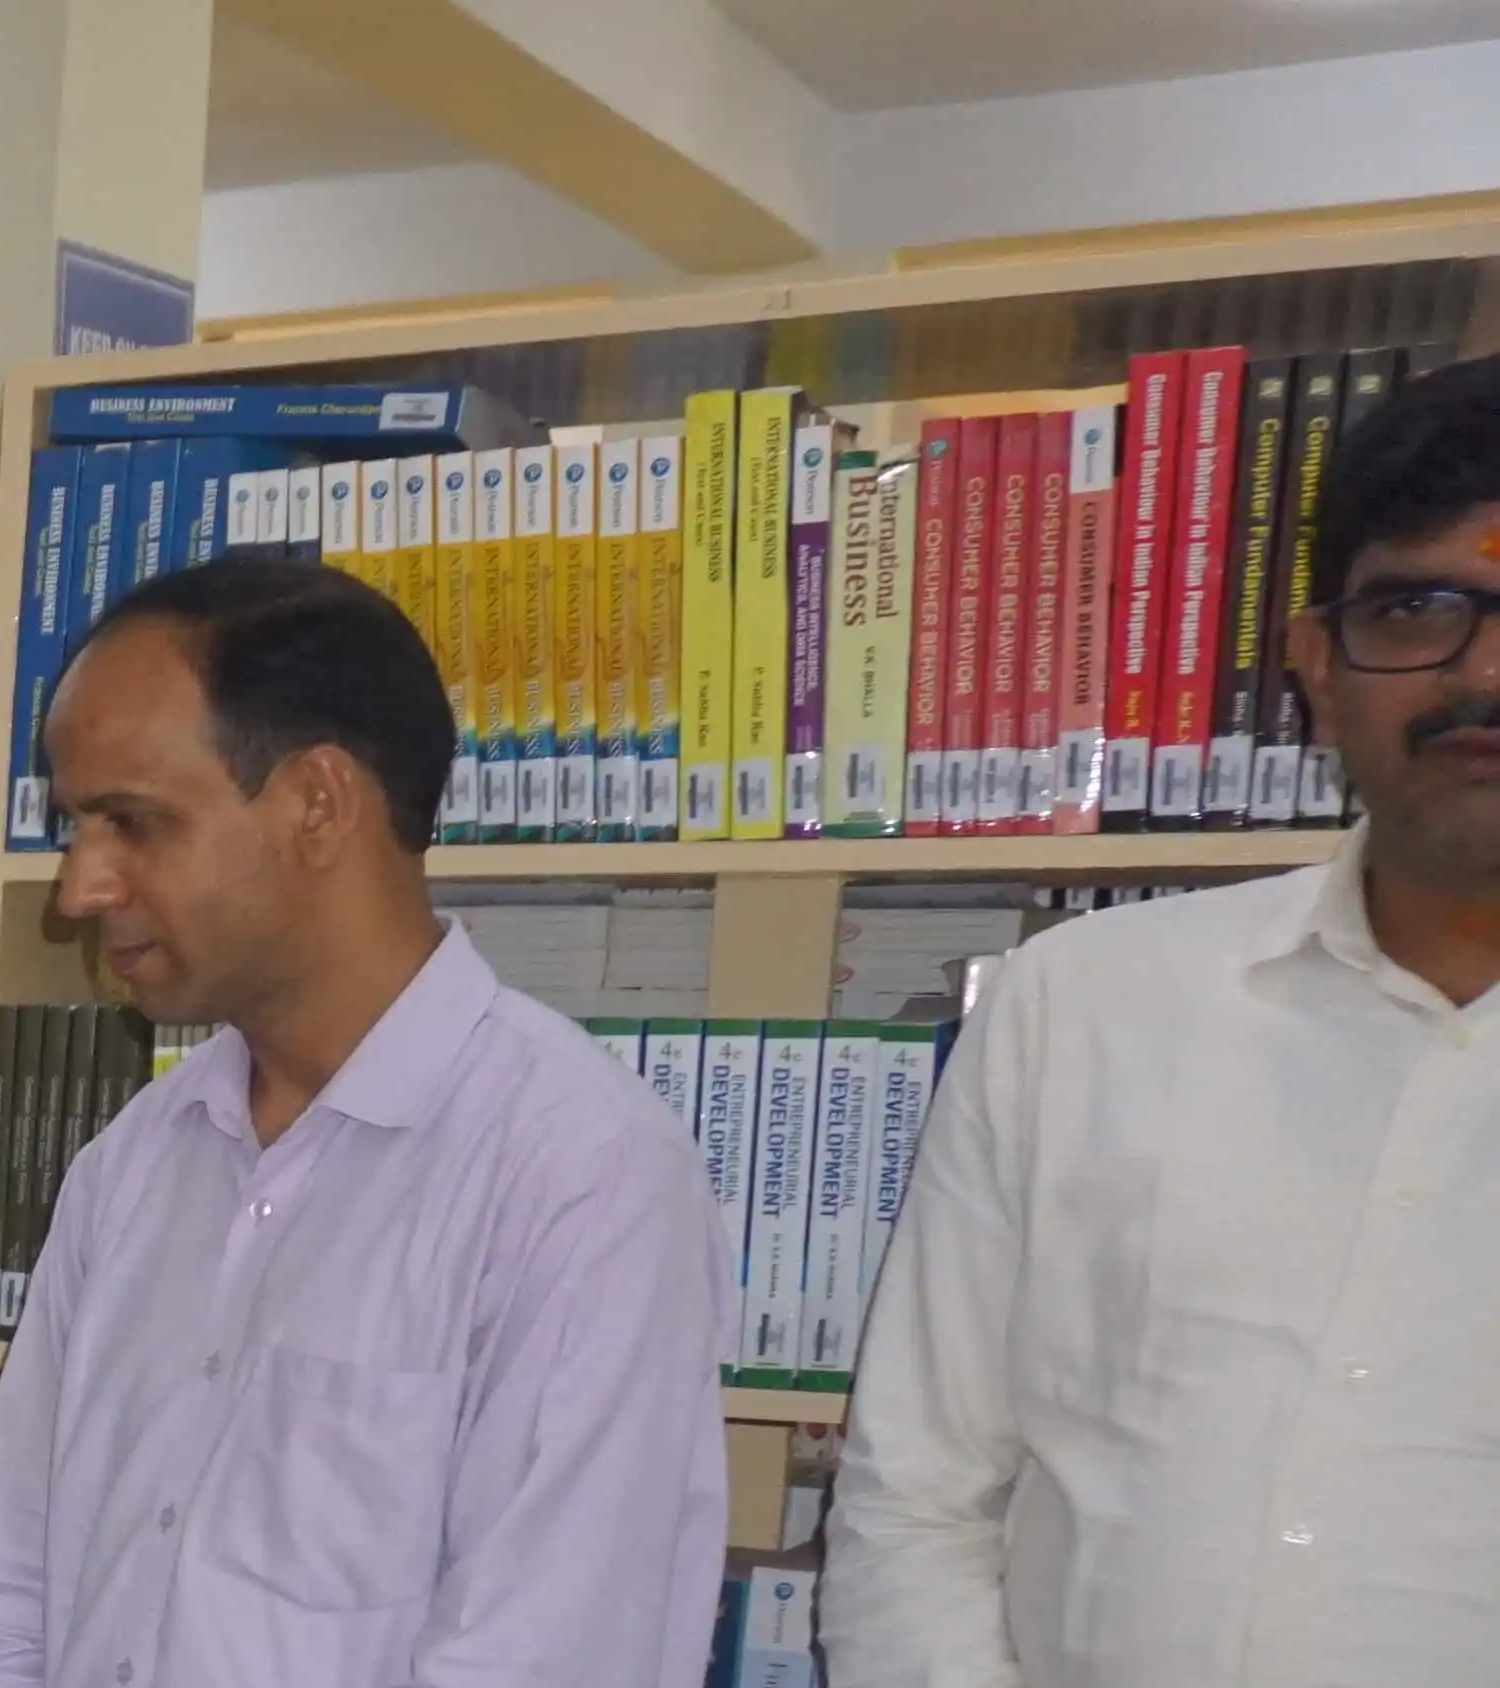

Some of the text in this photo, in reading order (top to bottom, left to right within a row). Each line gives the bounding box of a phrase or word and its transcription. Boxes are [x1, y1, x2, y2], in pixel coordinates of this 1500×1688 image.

[90, 398, 236, 414] BUSINESS ENVIRONMENT
[1144, 374, 1167, 446] Consumer
[1199, 371, 1224, 446] Consumer
[1299, 416, 1330, 517] Computer
[100, 484, 116, 544] BUSINESS
[876, 474, 902, 619] nternational
[1137, 446, 1162, 522] Behaviour
[1189, 446, 1218, 522] Behaviour
[1235, 418, 1282, 670] Computer Fundamentals
[41, 487, 66, 635] BUSINESS ENVIRONMENT
[844, 476, 878, 627] Business
[954, 476, 985, 696] CONSUMER BEHAVIOR
[996, 474, 1025, 694] CONSUMER BEHAVIOR
[1033, 472, 1063, 694] CONSUMER BEHAVIOR
[1074, 501, 1098, 706] CONSUMER BEHAVIOR
[1132, 541, 1156, 588] Indian
[1183, 541, 1209, 588] Indian
[917, 518, 943, 725] CONSUMER BEHAVIOR
[1124, 590, 1152, 675] Perspective
[1176, 590, 1204, 676] Perspective
[721, 1074, 747, 1206] ENTREPRENEURIAL
[763, 1068, 791, 1219] DEVELOPMENT
[782, 1077, 806, 1211] ENTREPRENEURIAL
[820, 1067, 850, 1220] DEVELOPMENT
[840, 1076, 866, 1210] ENTREPRENEURIAL
[877, 1072, 906, 1223] DEVELOPMENT
